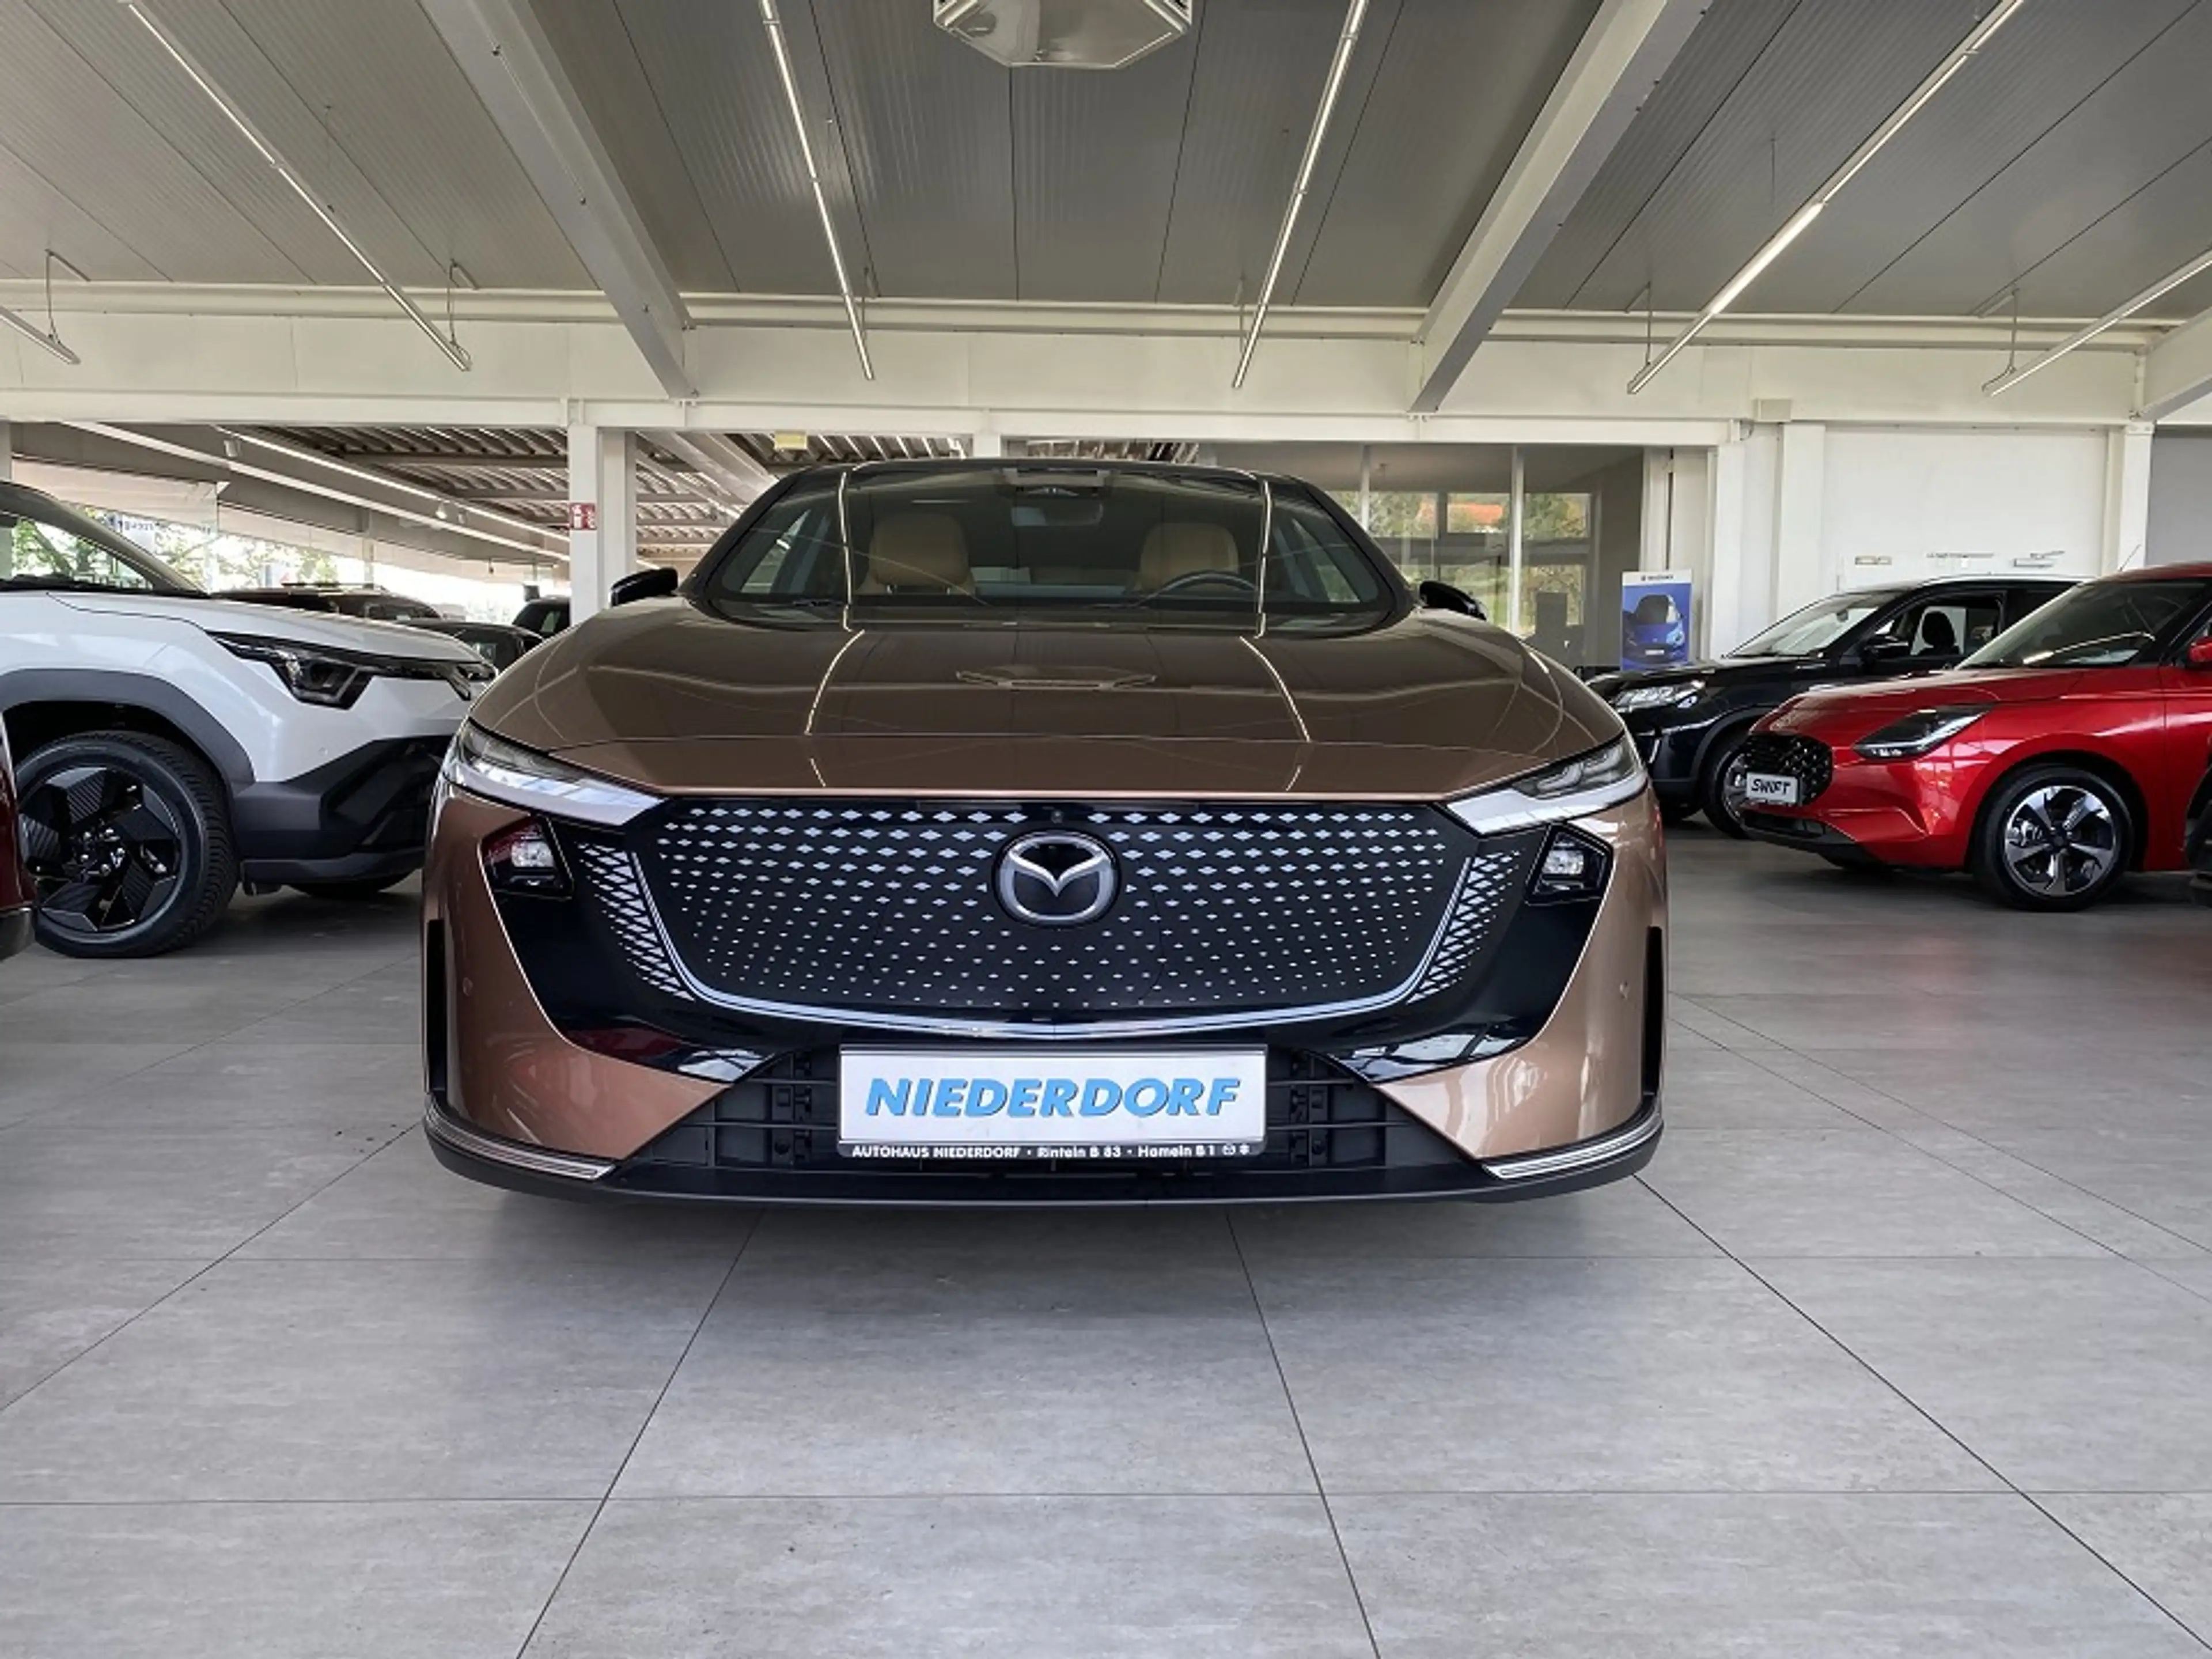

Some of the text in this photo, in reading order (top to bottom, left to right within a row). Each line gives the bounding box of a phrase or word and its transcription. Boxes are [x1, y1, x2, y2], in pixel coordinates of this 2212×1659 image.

[1751, 779, 1791, 794] SWIFT
[866, 1078, 1240, 1117] NIEDERDORF
[853, 1145, 929, 1158] AUTOHAUS
[933, 1146, 1020, 1158] NIEDERDORF
